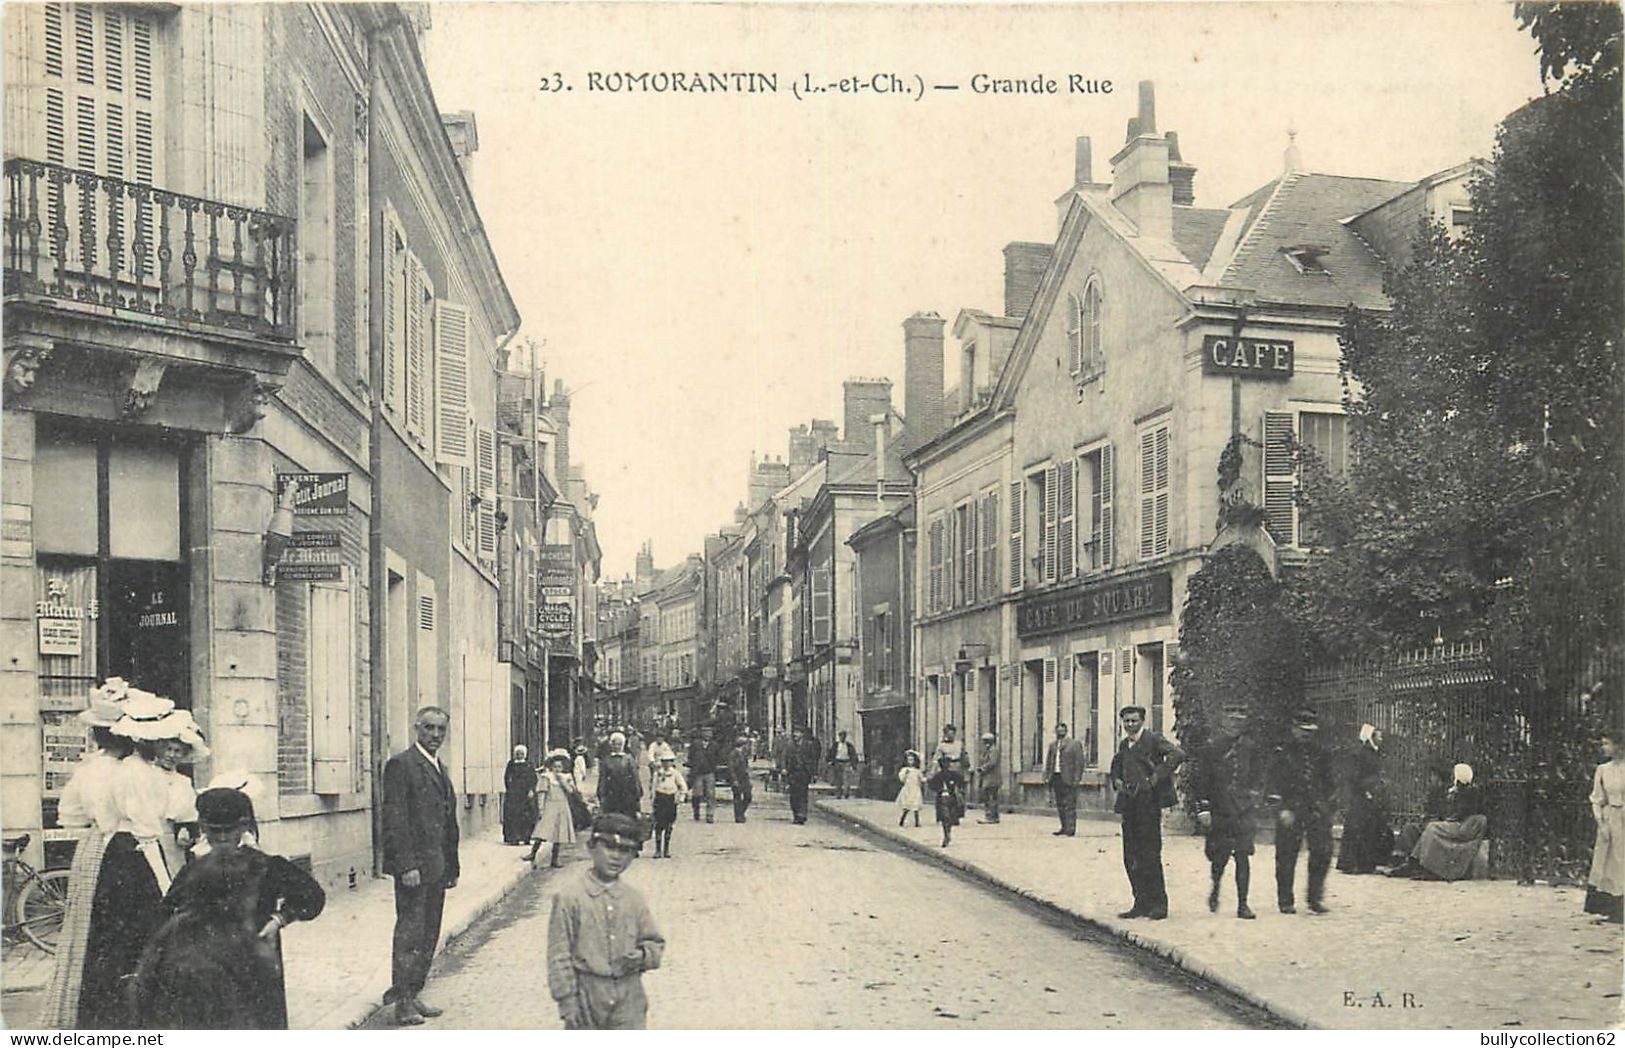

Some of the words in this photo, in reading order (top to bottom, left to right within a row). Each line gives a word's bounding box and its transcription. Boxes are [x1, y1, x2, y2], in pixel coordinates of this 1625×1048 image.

[1212, 340, 1290, 371] CAFE
[311, 475, 347, 500] Journal
[295, 548, 340, 563] Matin
[152, 591, 164, 605] LE
[139, 611, 178, 628] JOURNAL
[538, 614, 570, 623] CYCLES
